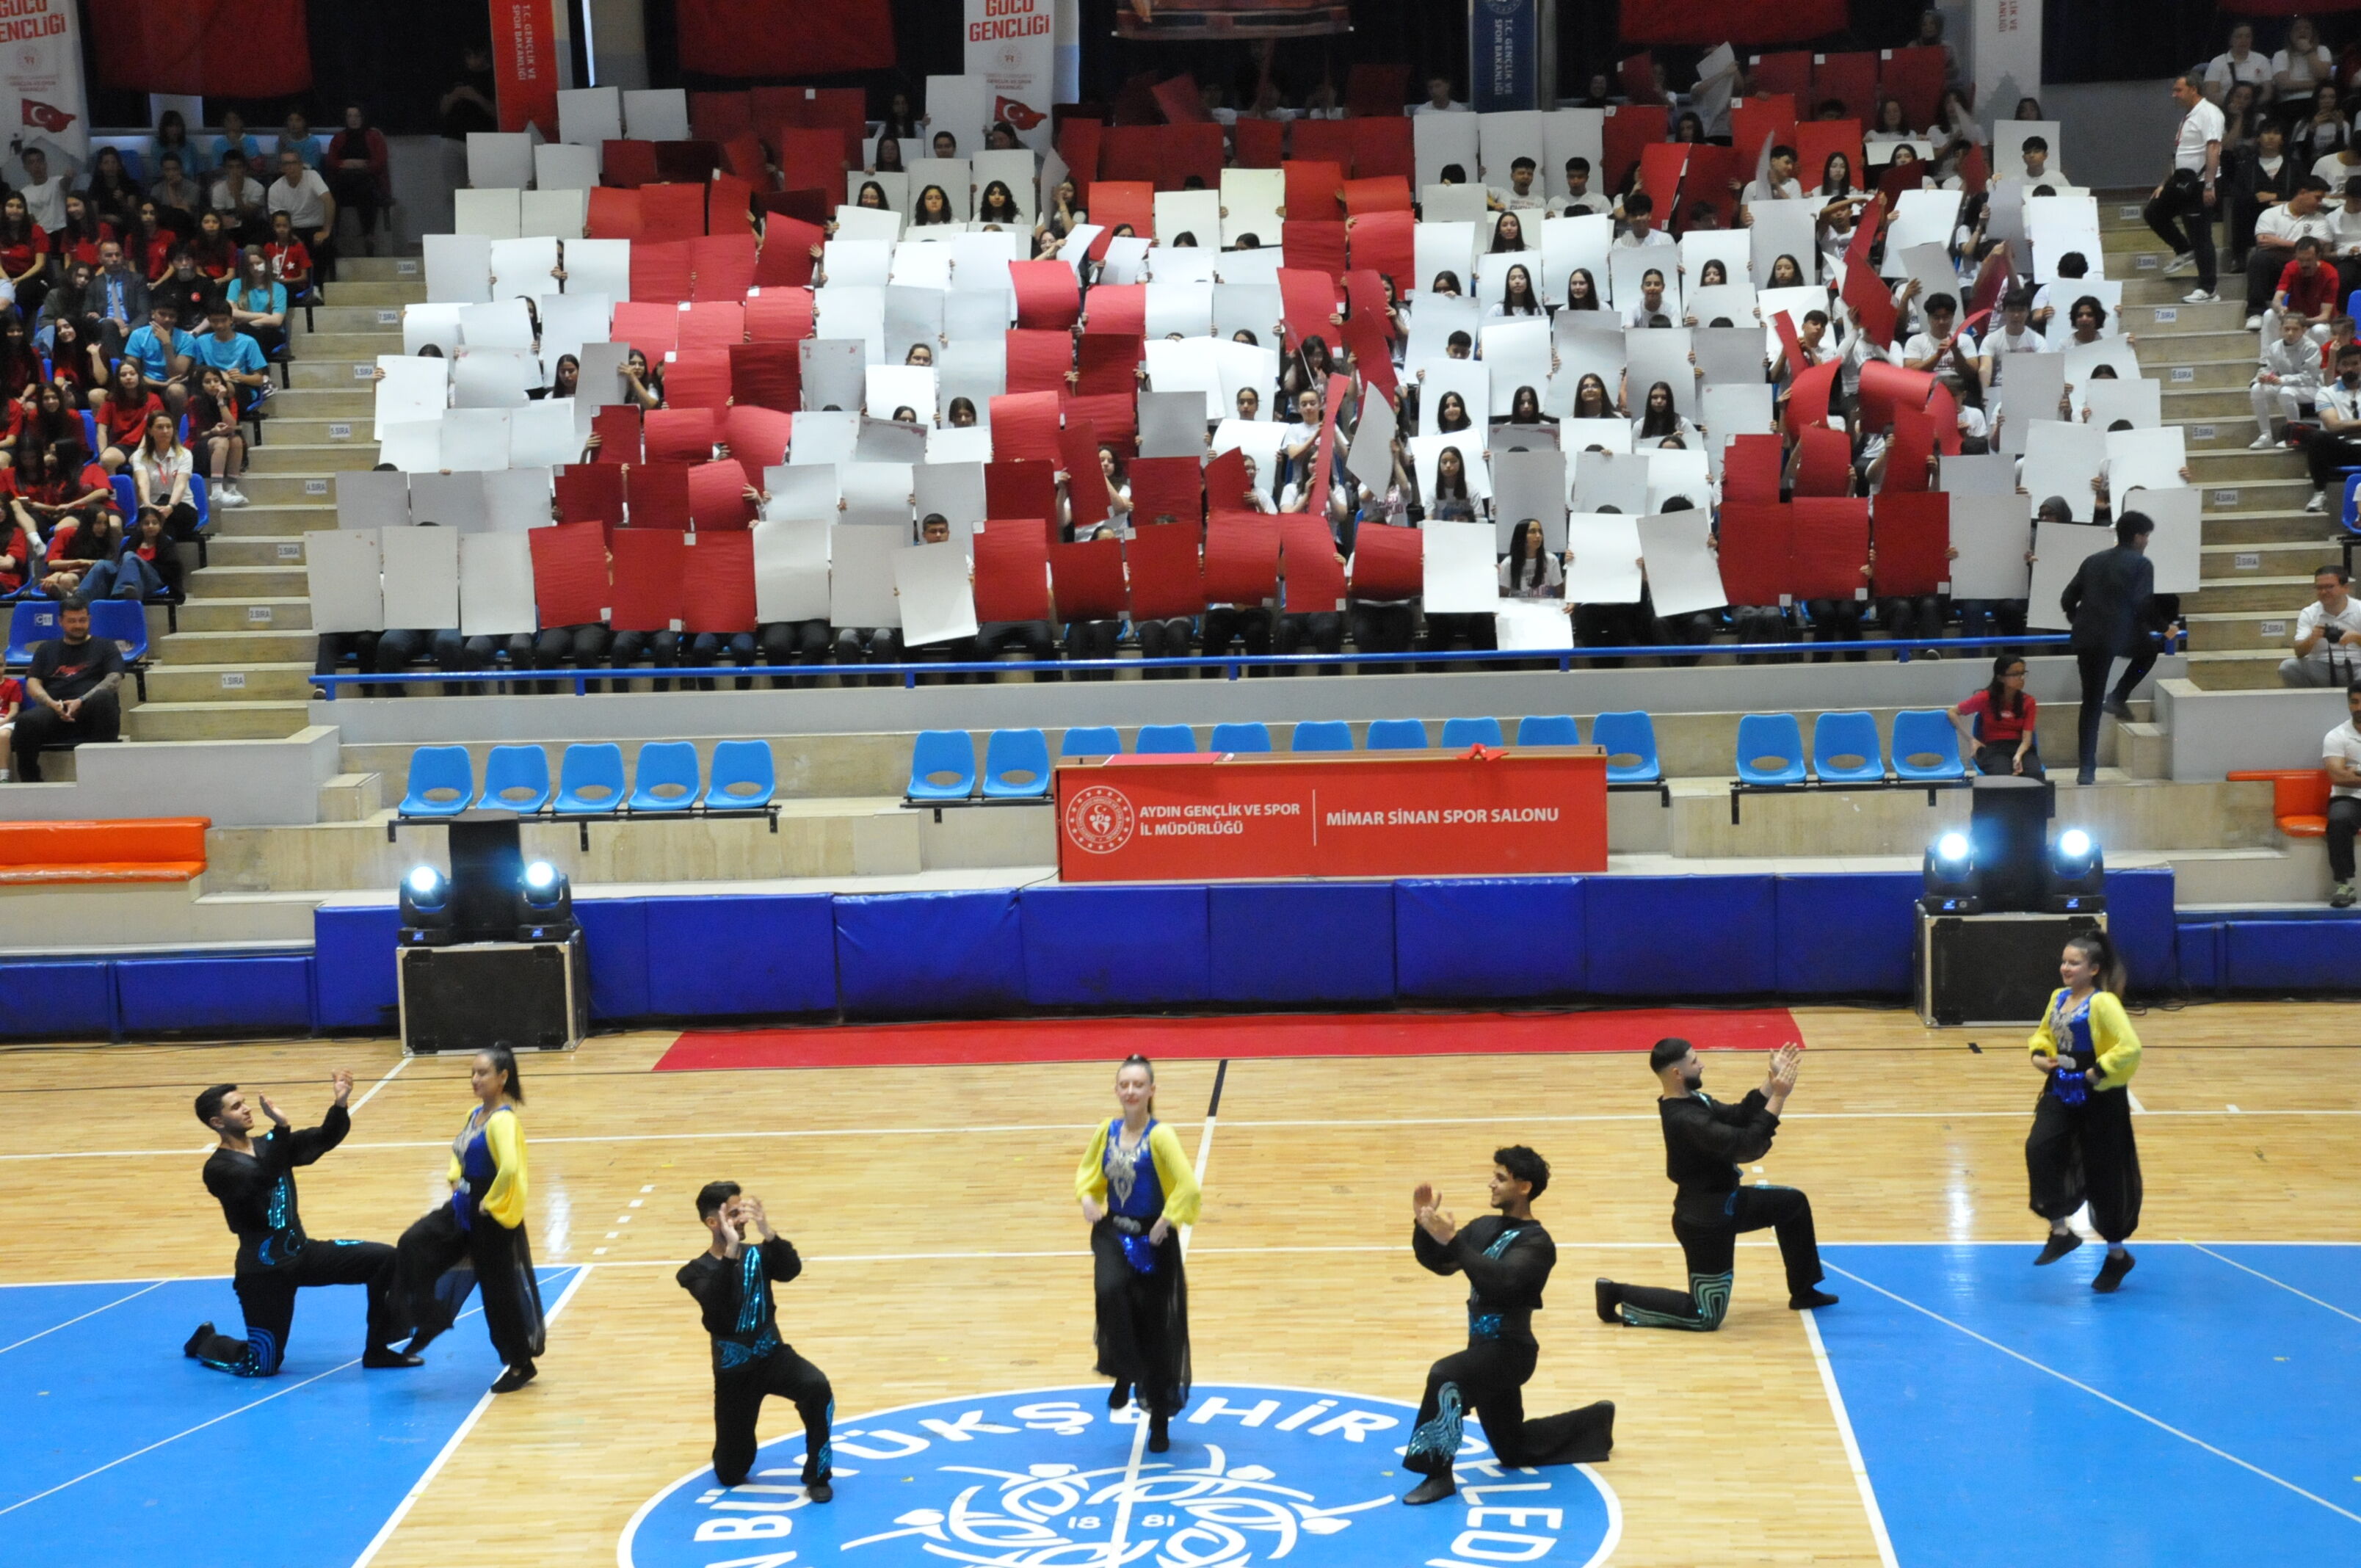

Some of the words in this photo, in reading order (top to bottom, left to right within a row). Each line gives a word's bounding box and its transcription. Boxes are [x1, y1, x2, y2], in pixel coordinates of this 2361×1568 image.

[512, 4, 521, 29] SPOR
[1495, 19, 1504, 43] SPOR
[2155, 310, 2175, 319] 7.SIRA
[2216, 492, 2236, 501] 4.SIRA
[2236, 556, 2257, 566] 3.SIRA
[250, 609, 270, 619] 2.SIRA
[2262, 623, 2283, 634] 2.SIRA
[222, 676, 244, 686] 1.SIRA
[1139, 806, 1181, 818] AYDIN
[1183, 802, 1242, 819] GENÇLİK
[1244, 805, 1261, 816] VE
[1263, 803, 1300, 816] SPOR
[1326, 810, 1385, 826] MİMAR
[1388, 808, 1439, 824] SİNAN
[1443, 809, 1487, 824] SPOR
[1490, 807, 1559, 822] SALONU
[1140, 821, 1153, 836] İL
[1154, 821, 1244, 836] MÜDÜRLÜĞÜ
[1067, 1516, 1101, 1529] 18
[1141, 1514, 1175, 1527] 81
